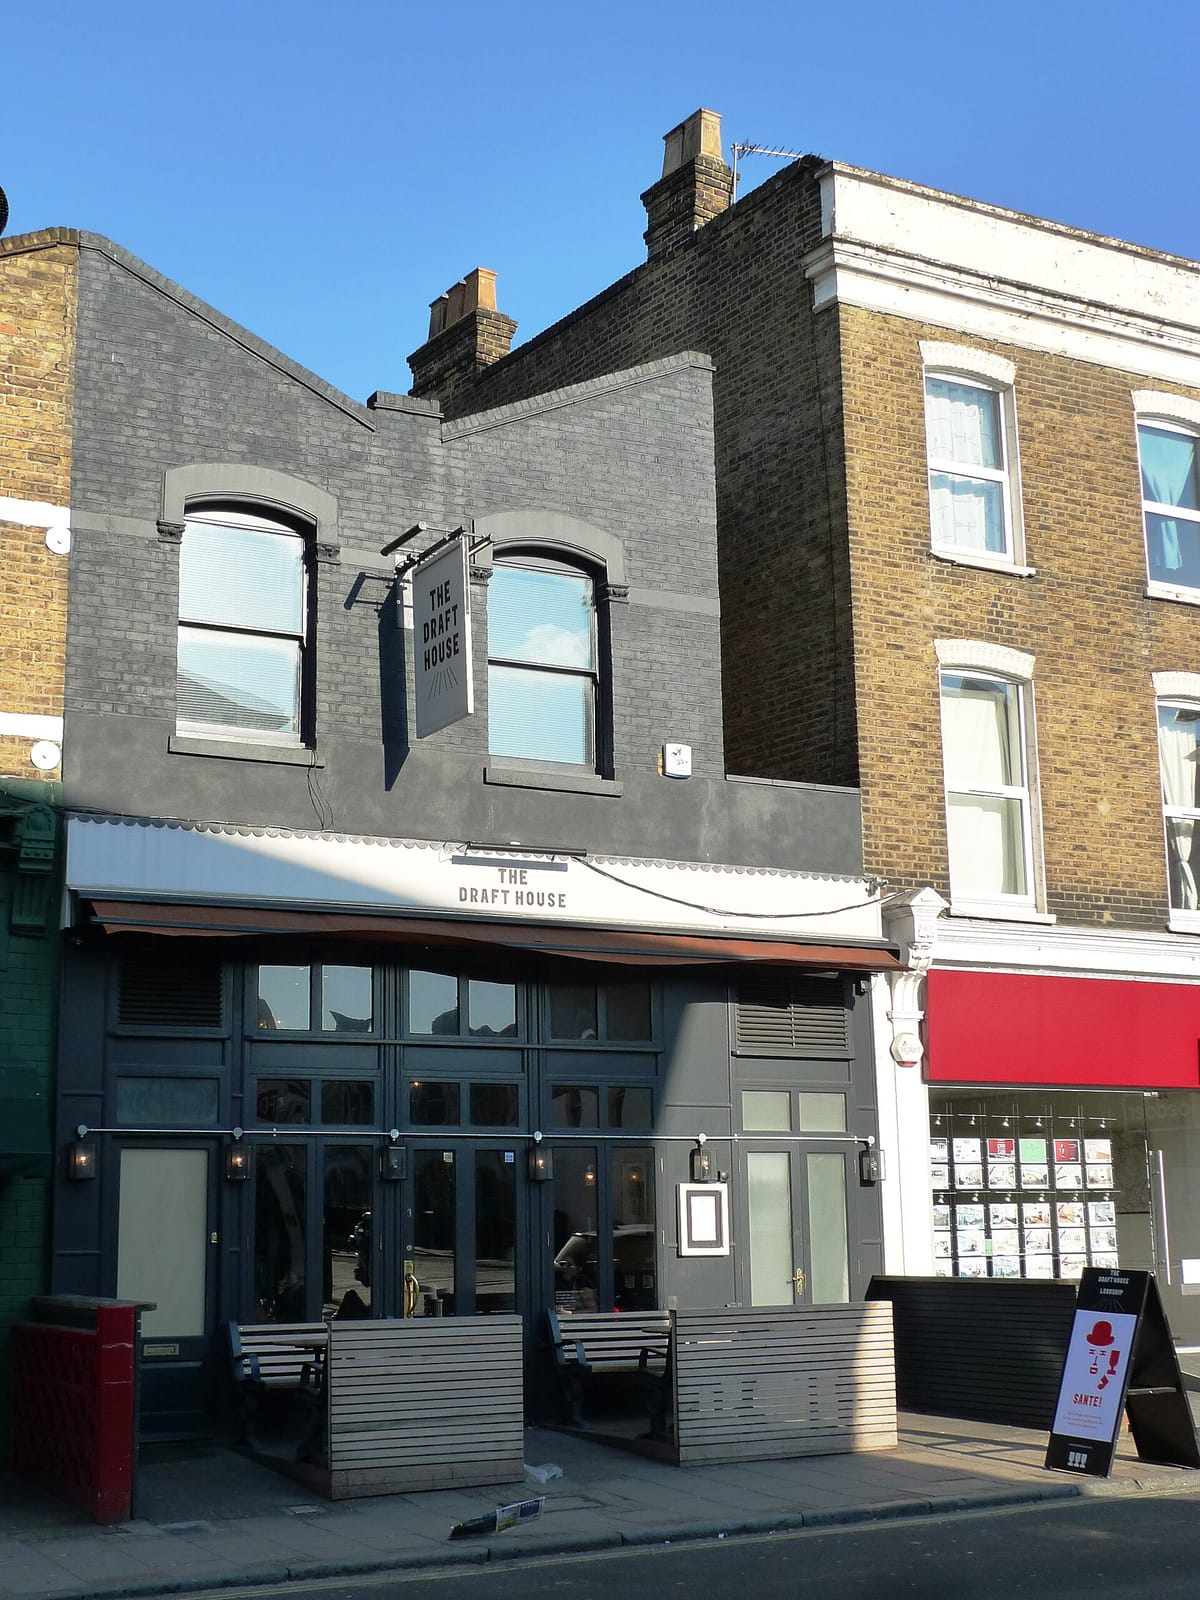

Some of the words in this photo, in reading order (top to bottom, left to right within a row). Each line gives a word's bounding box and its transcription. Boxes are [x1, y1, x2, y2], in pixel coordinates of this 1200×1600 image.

[429, 579, 451, 611] THE
[423, 604, 458, 644] DRAFT
[424, 632, 459, 672] HOUSE
[498, 868, 528, 885] THE
[459, 887, 510, 905] DRAFT
[515, 891, 566, 908] HOUSE
[1073, 1393, 1103, 1408] SANTE!
